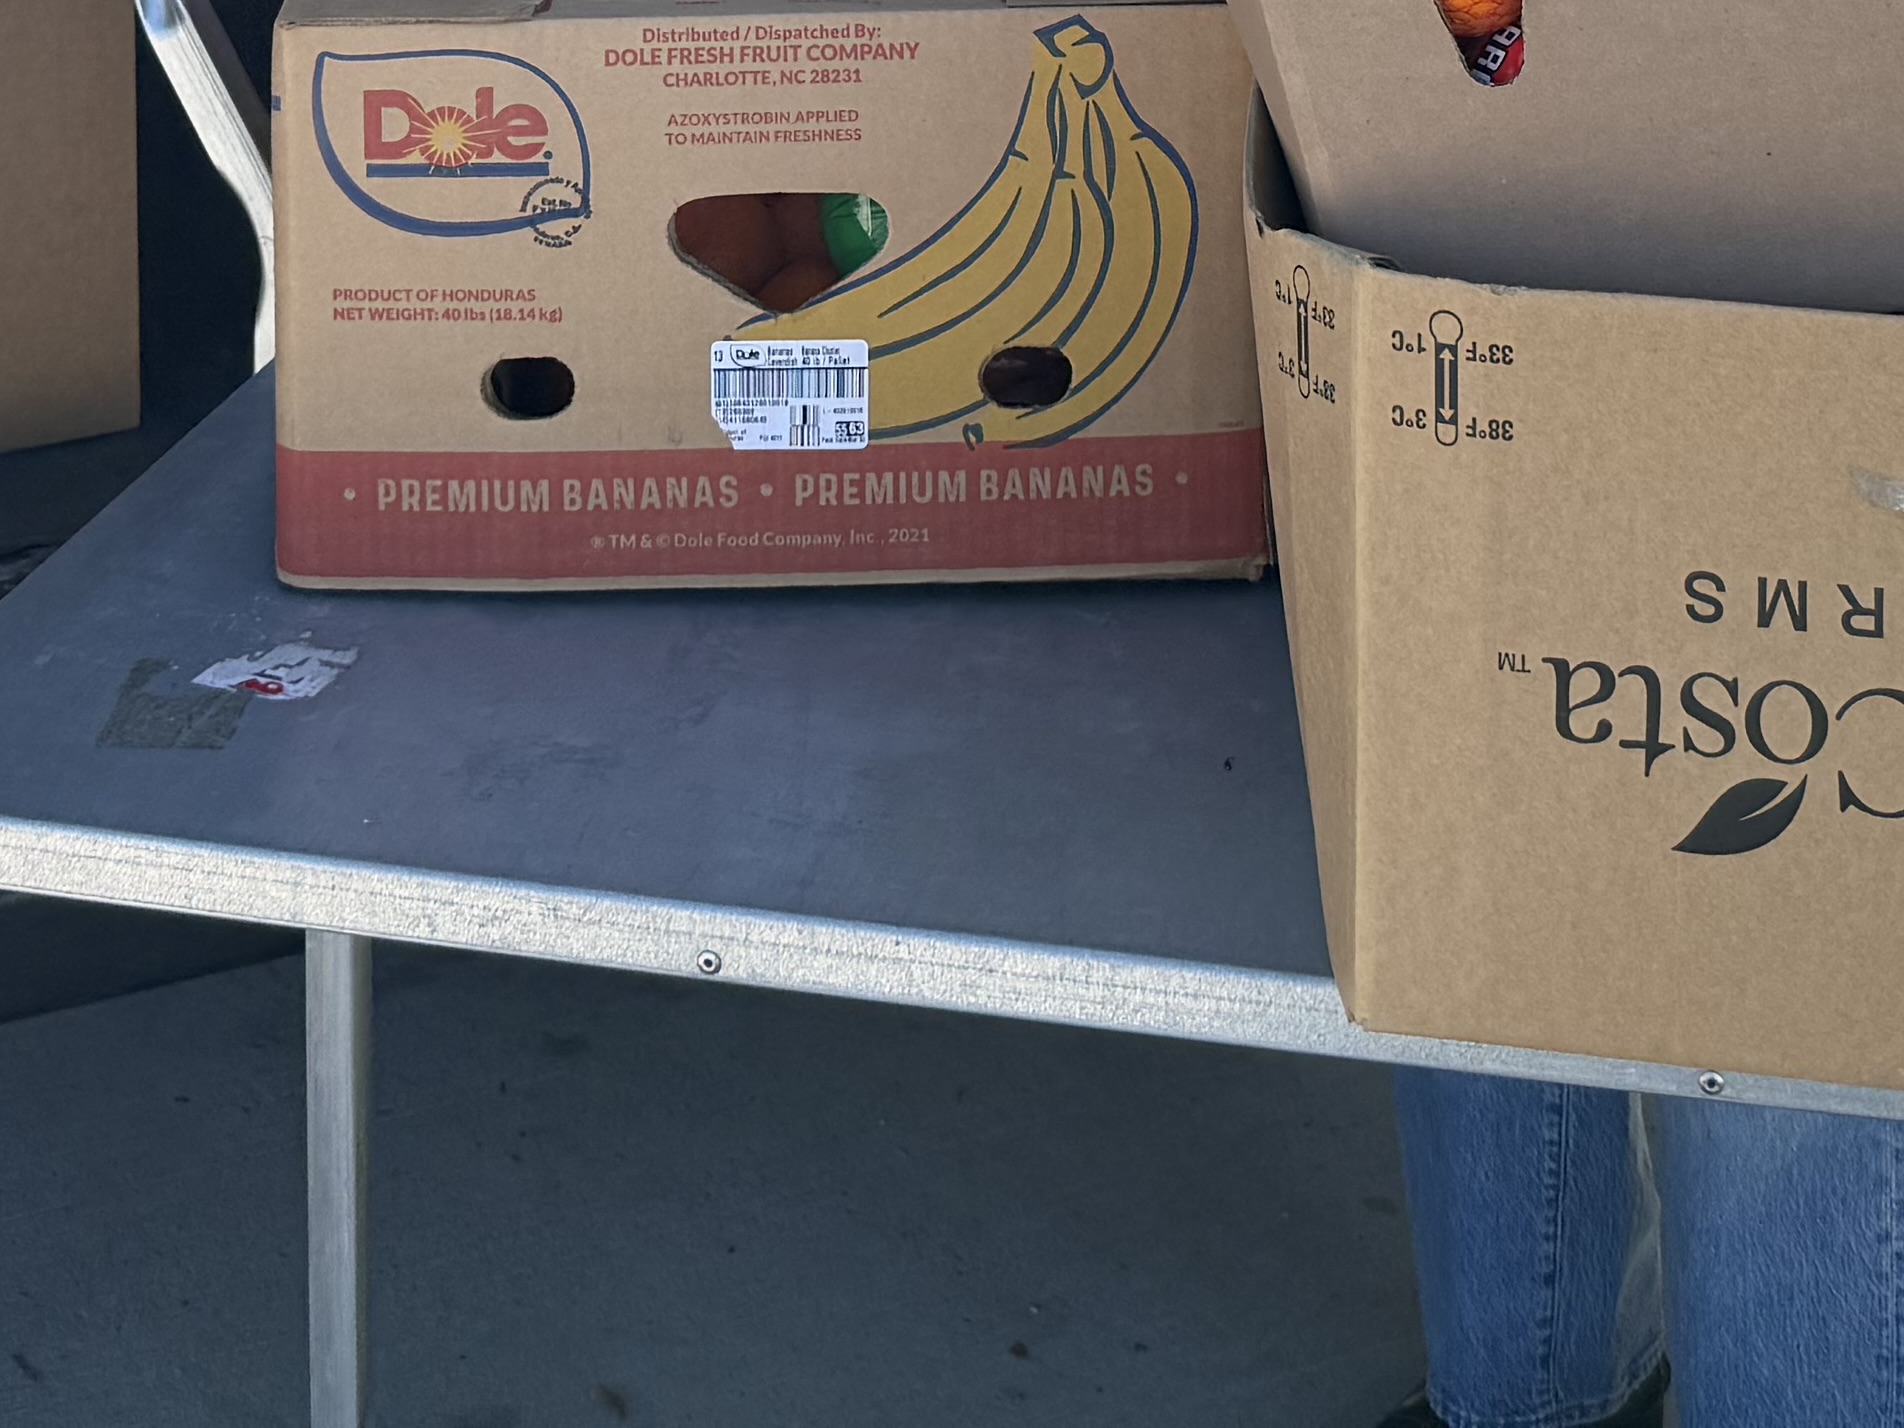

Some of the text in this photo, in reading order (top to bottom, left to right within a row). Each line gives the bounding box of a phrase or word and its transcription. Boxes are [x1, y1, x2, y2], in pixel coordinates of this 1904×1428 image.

[642, 25, 740, 43] Distributed
[754, 22, 851, 44] Dispatched
[854, 22, 882, 42] By:
[603, 42, 921, 67] DOLE FRESH FRUIT COMPANY
[662, 68, 863, 89] CHARLOTTE, NC 28231
[362, 86, 550, 168] Dole
[667, 109, 860, 127] AZOXYSTROBIN APPLIED
[664, 128, 863, 146] TO MAINTAIN FRESHNESS
[332, 287, 537, 303] PRODUCT OF HONDURAS
[332, 306, 564, 324] NET WEIGHT: 40 lbs (18.14 kg)
[1391, 329, 1427, 355] 1°C
[735, 348, 761, 361] Dole
[1465, 341, 1514, 366] 33°F
[1391, 404, 1427, 430] 3°C
[1465, 416, 1514, 442] 38°F
[376, 474, 741, 513] PREMIUM BANANAS
[794, 463, 1155, 507] PREMIUM BANANAS
[608, 533, 637, 549] TM
[673, 531, 713, 548] Dole
[717, 531, 759, 548] Food
[887, 527, 930, 544] 2021
[1496, 651, 1532, 672] TM
